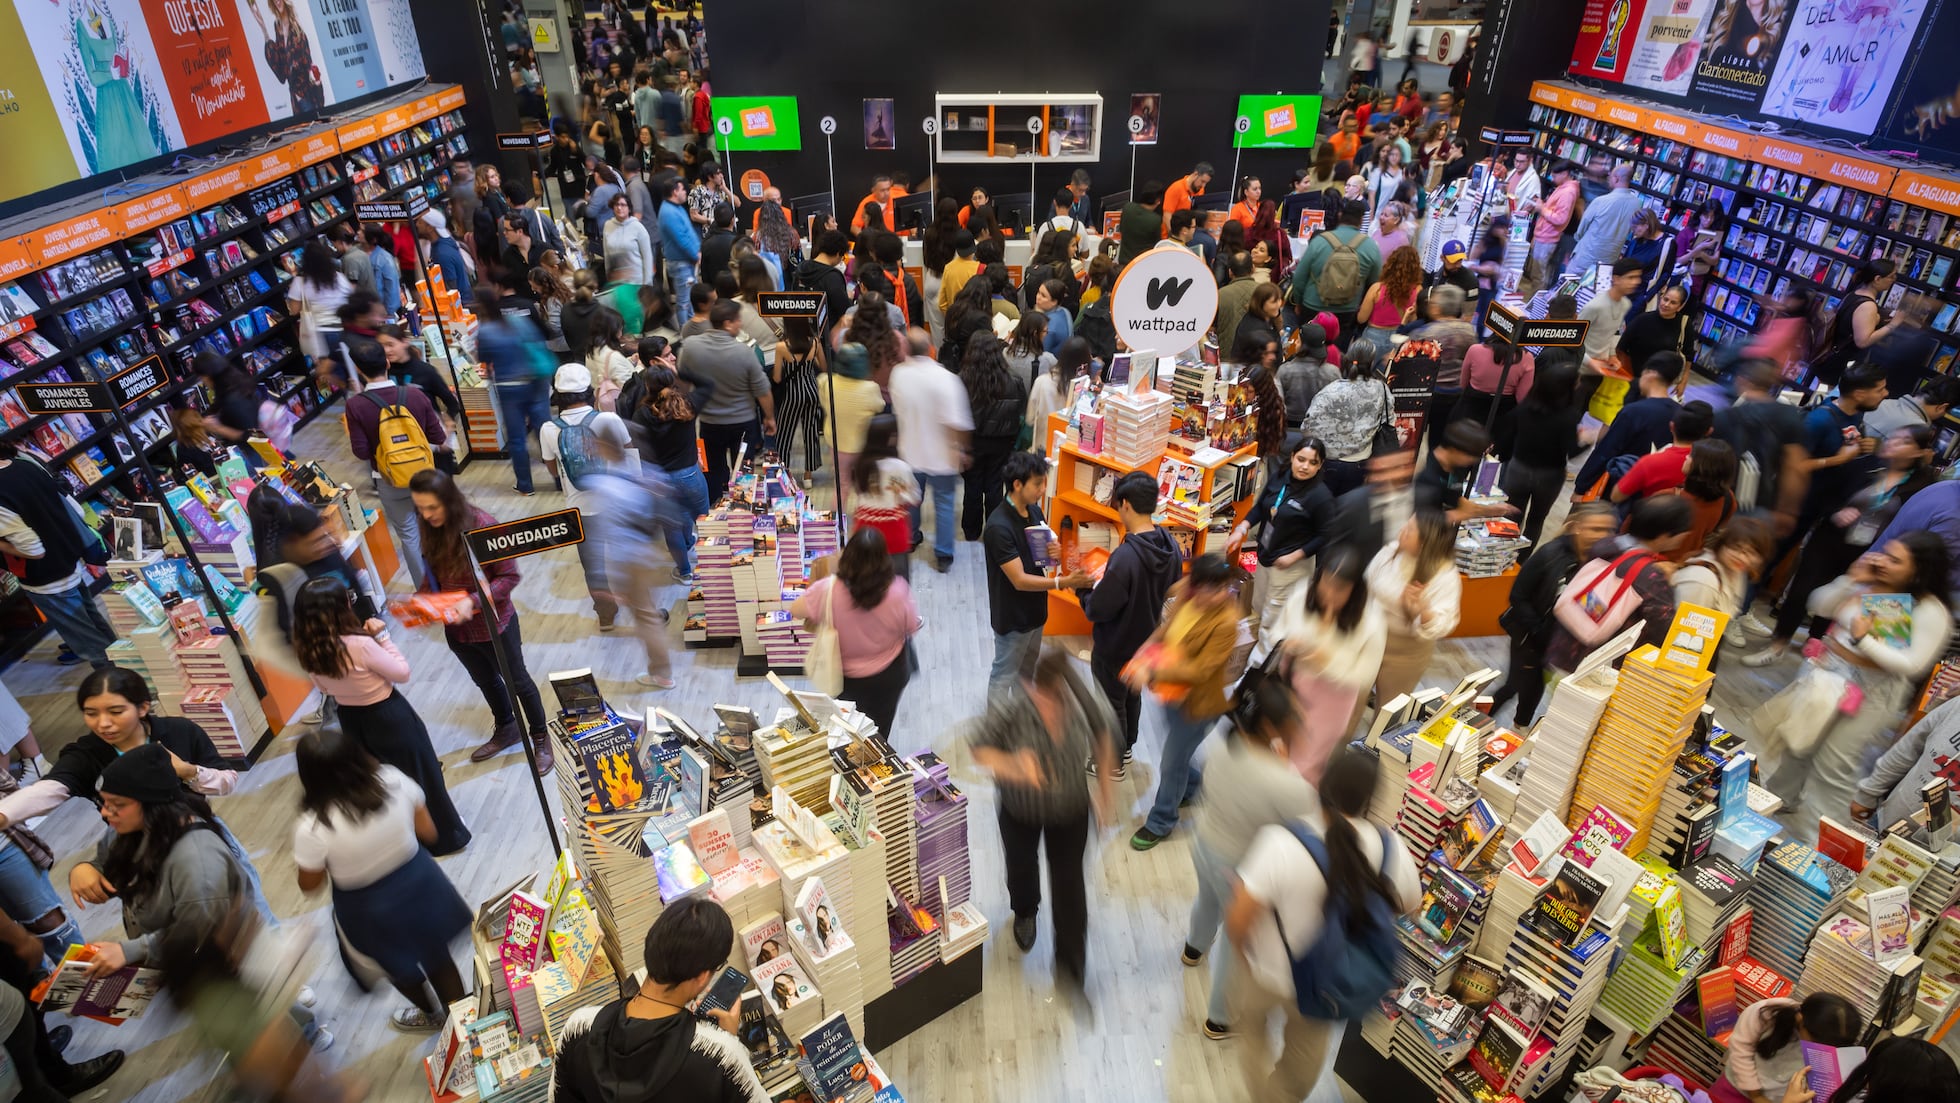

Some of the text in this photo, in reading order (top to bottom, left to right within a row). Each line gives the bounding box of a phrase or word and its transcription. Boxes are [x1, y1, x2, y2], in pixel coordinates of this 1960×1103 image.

[1805, 4, 1836, 26] DEL
[327, 16, 363, 39] DEL TODO
[1650, 23, 1692, 39] porvenir
[1721, 54, 1751, 68] LÍDER
[1698, 61, 1767, 87] Clariconectado
[190, 78, 246, 120] Movimiento
[1608, 106, 1639, 124] ALFAGUARA
[721, 120, 728, 132] 1
[824, 120, 833, 131] 2
[926, 120, 934, 131] 3
[1031, 119, 1040, 131] 4
[1132, 119, 1140, 131] 5
[1239, 119, 1247, 131] 6
[1653, 118, 1688, 136] ALFAGUARA
[502, 138, 531, 146] NOVEDADES
[1703, 131, 1740, 152] ALFAGUARA
[1762, 145, 1805, 166] ALFAGUARA
[1829, 162, 1881, 186] ALFAGUARA
[127, 203, 146, 218] JUVENIL
[148, 196, 164, 210] LIBROS
[164, 193, 173, 204] DE
[358, 211, 383, 219] HISTORIA
[43, 228, 69, 244] JUVENIL
[72, 219, 92, 235] LIBROS
[91, 217, 101, 228] DE
[69, 236, 88, 252] MAGIA
[90, 228, 111, 244] SUEÑOS
[2, 258, 29, 276] NOVELA
[767, 299, 817, 310] NOVEDADES
[1128, 317, 1197, 334] wattpad
[1489, 310, 1514, 334] NOVEDADES
[1526, 327, 1578, 339] NOVEDADES
[118, 364, 154, 390] ROMANCES
[35, 387, 89, 399] ROMANCES
[124, 374, 158, 400] JUVENILES
[43, 398, 94, 409] JUVENILES
[486, 522, 569, 552] NOVEDADES
[580, 732, 628, 757] Placeres
[593, 740, 634, 762] ocultos
[698, 832, 732, 850] SUNSETS
[707, 829, 719, 840] 30
[1590, 829, 1609, 846] WTF
[706, 842, 728, 854] PARA
[1582, 836, 1602, 857] VOTO
[1571, 866, 1598, 887] FRANCISCO
[1581, 878, 1602, 897] MORENO
[1432, 888, 1449, 906] SANTA
[1550, 898, 1580, 922] DIME QUE
[516, 918, 532, 932] WTF
[1556, 911, 1579, 933] CIERTO
[748, 923, 782, 947] VENTANA
[756, 959, 793, 981] VENTANA
[1735, 961, 1753, 976] NEO
[1743, 965, 1768, 985] LIBERA
[1755, 971, 1779, 992] LISMO
[816, 1031, 843, 1053] PODER
[822, 1029, 831, 1040] El
[815, 1041, 855, 1070] reinventarte
[828, 1045, 837, 1055] de
[826, 1073, 845, 1087] Lucy
